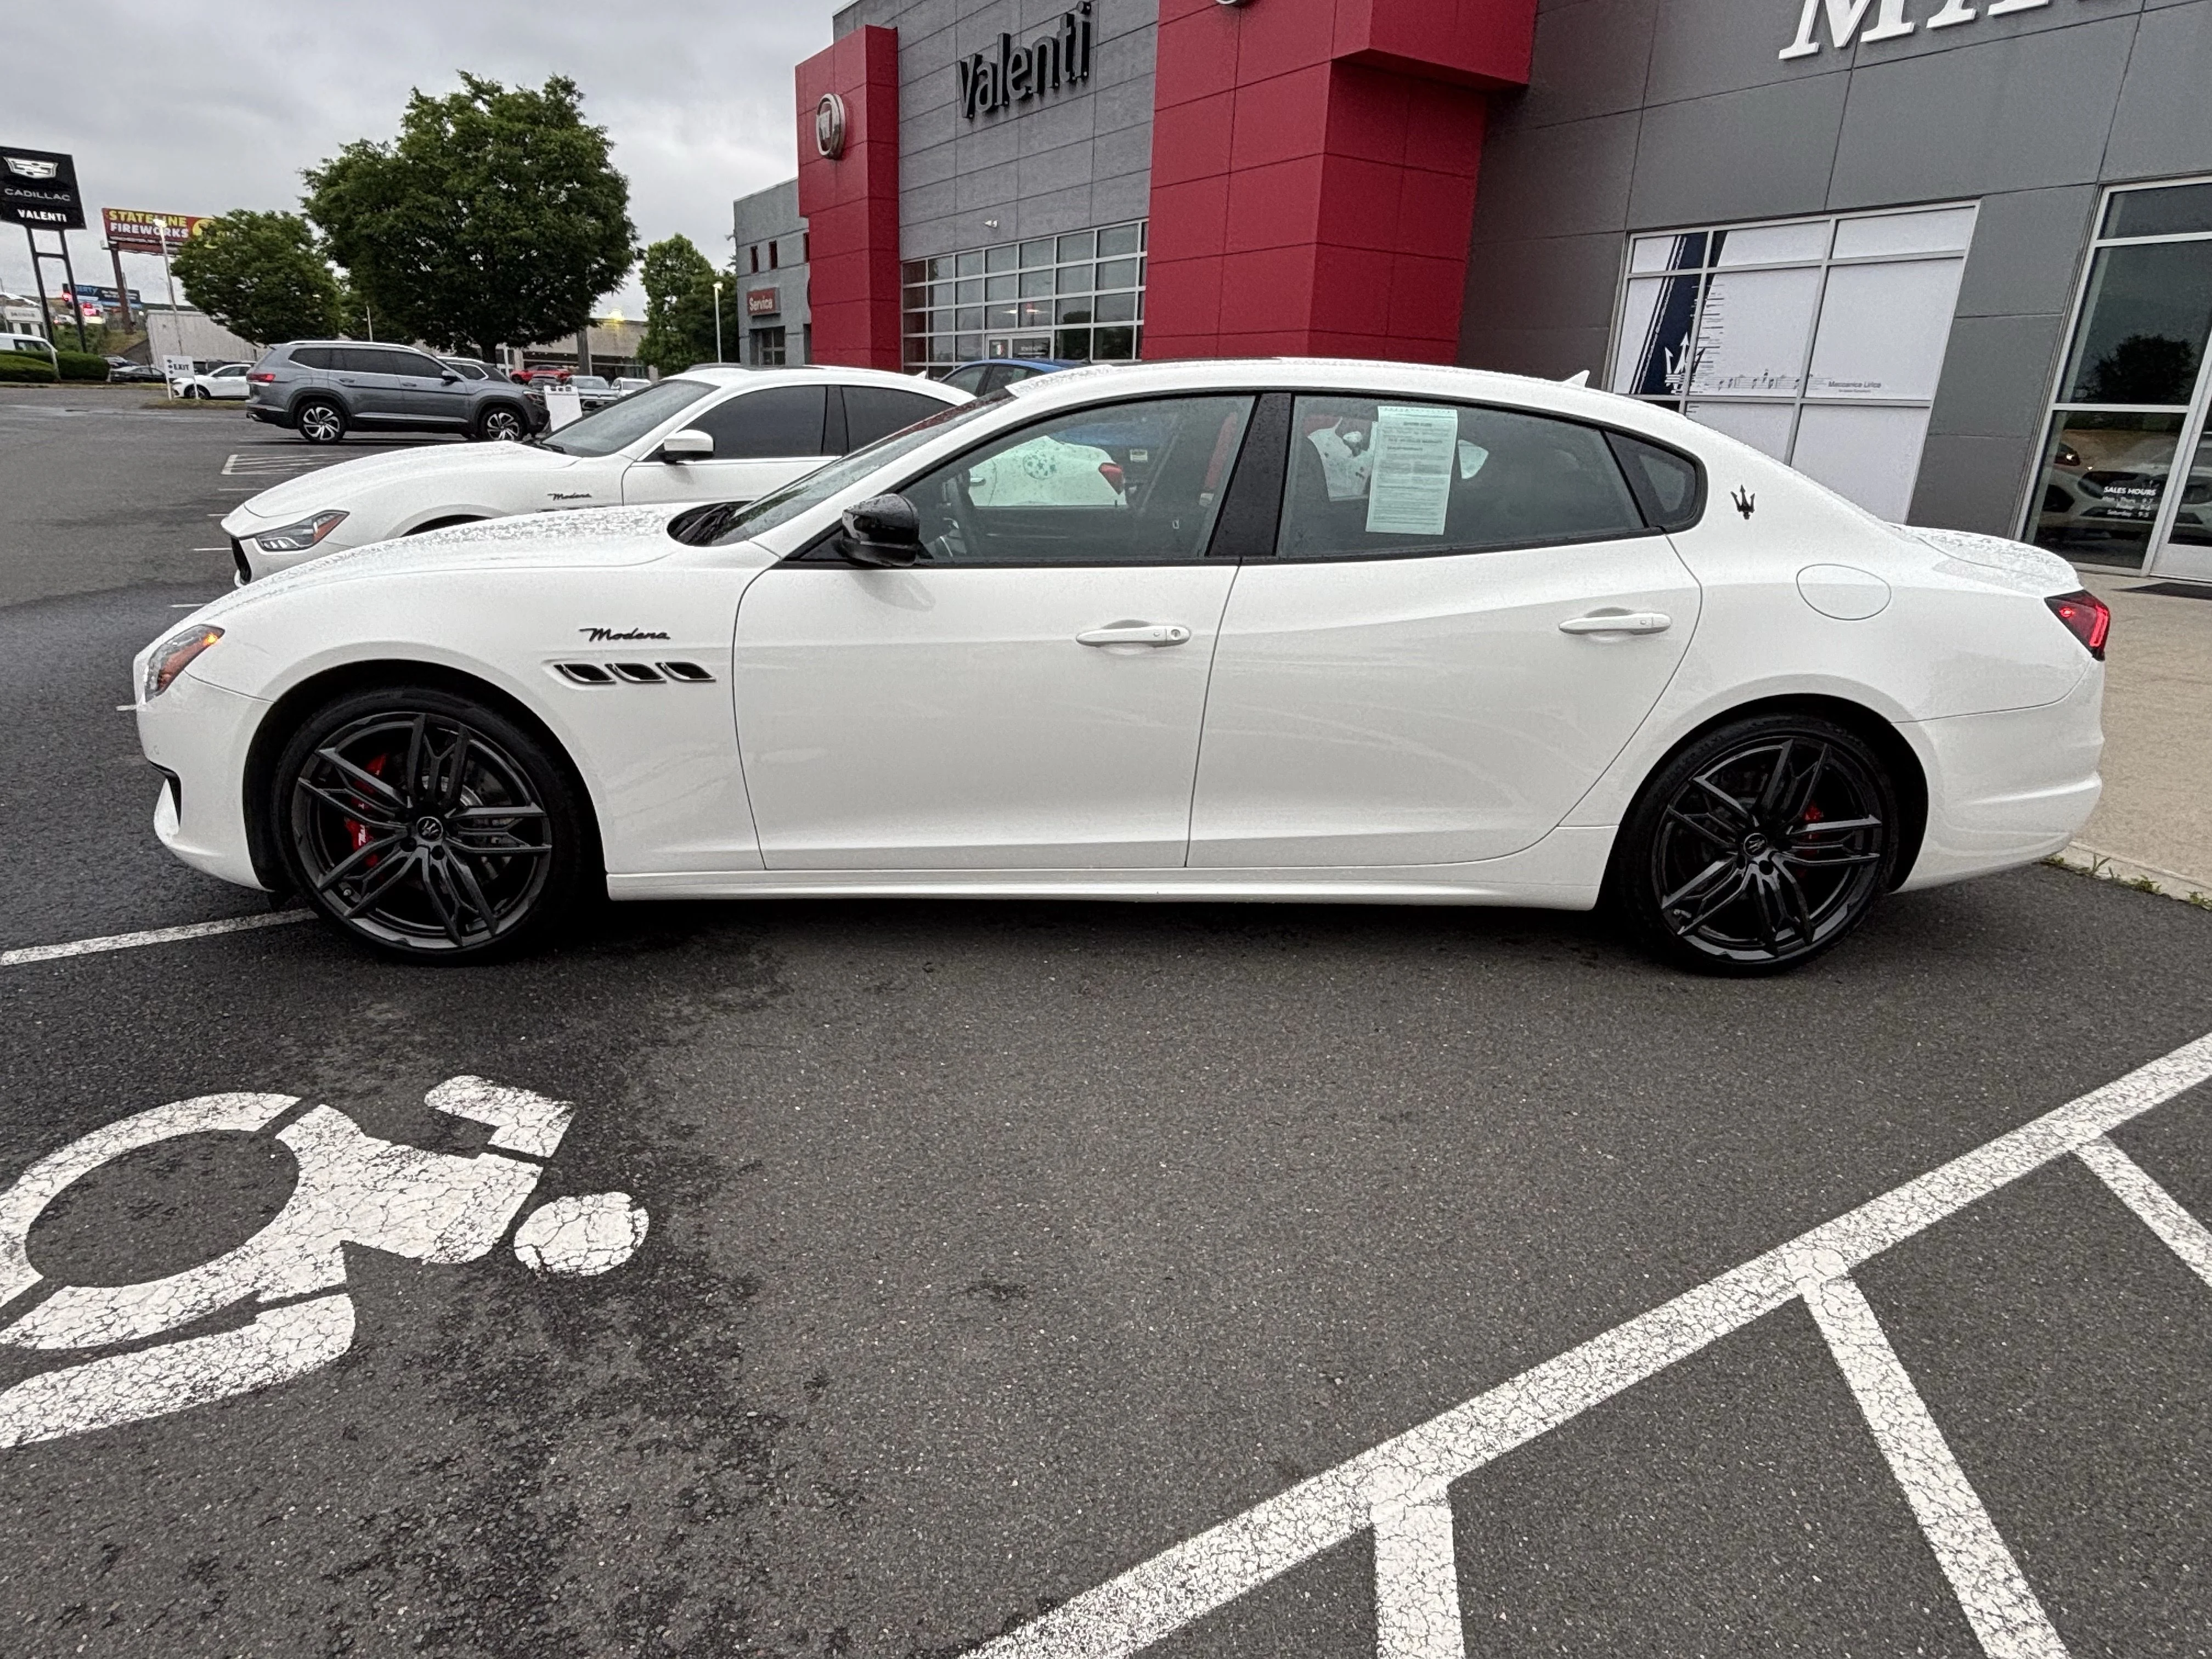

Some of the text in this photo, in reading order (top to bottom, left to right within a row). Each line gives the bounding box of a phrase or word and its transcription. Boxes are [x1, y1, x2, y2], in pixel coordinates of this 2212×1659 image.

[955, 1, 1091, 118] Valenti
[4, 188, 71, 202] CADILLAC
[17, 208, 67, 222] VALENTI
[110, 222, 189, 238] FIREWORKS
[749, 296, 772, 311] Service
[2127, 488, 2157, 496] HOURS
[579, 628, 671, 642] Modena
